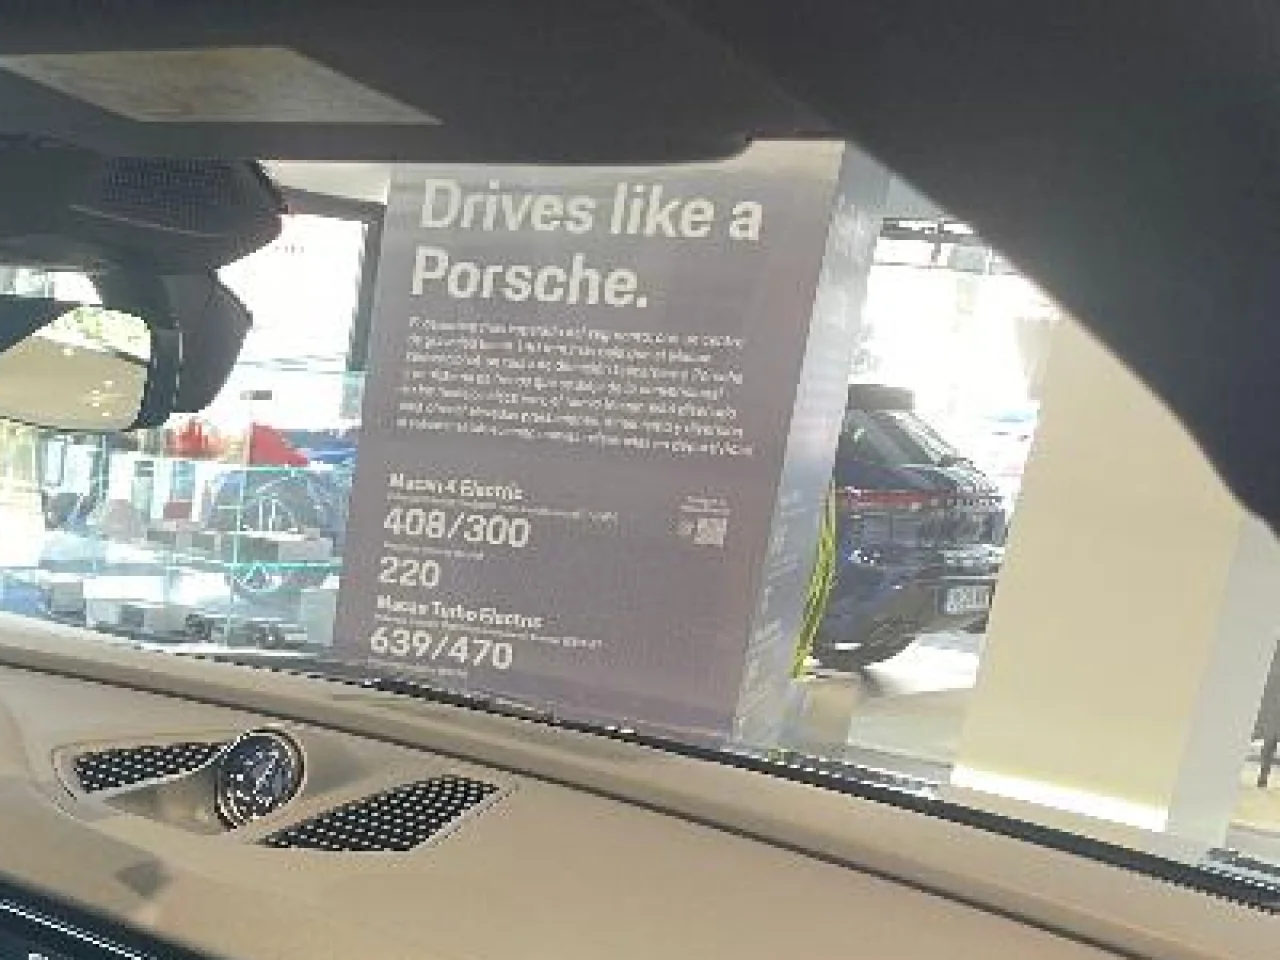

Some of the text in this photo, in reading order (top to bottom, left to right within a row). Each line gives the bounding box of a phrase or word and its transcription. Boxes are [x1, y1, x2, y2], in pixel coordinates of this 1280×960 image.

[420, 178, 764, 241] Drives like a
[409, 246, 648, 308] Porsche.
[383, 507, 531, 548] 408/300
[379, 556, 441, 588] 220
[370, 627, 513, 670] 639/470
